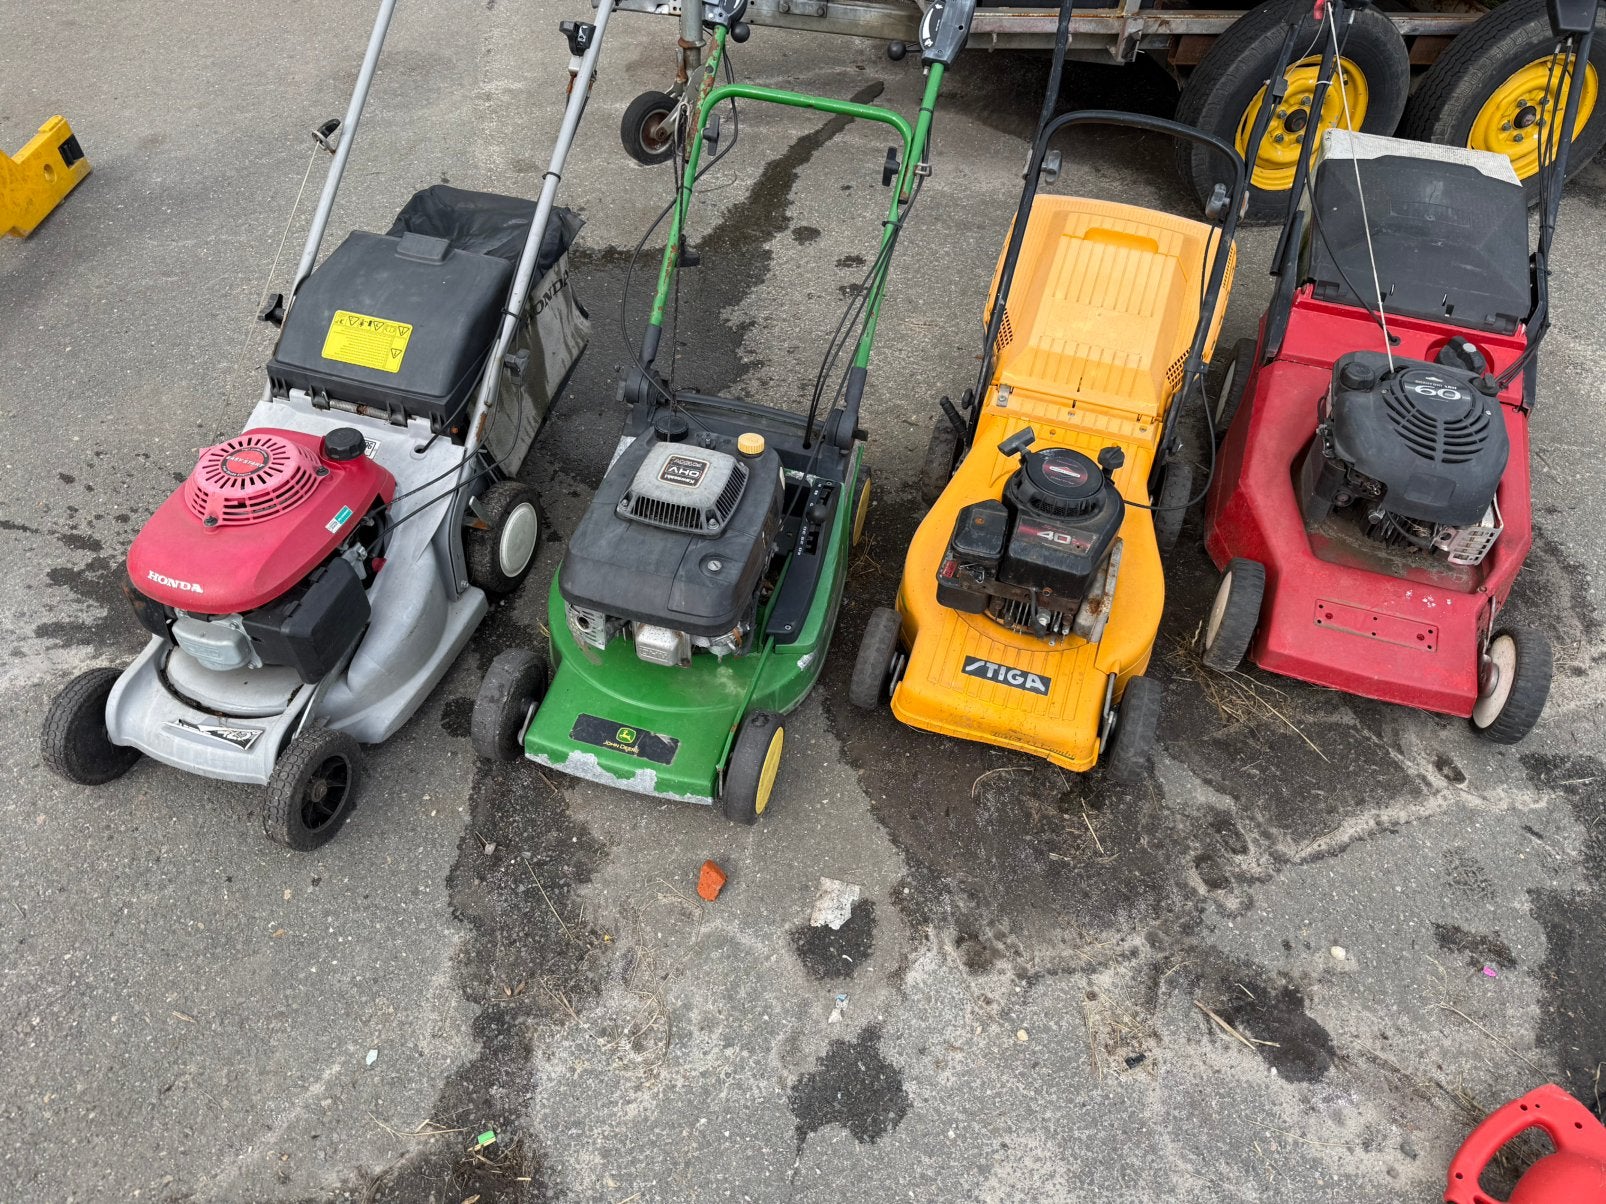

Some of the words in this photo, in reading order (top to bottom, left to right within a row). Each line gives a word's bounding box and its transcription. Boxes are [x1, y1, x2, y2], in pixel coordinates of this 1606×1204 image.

[1414, 385, 1461, 400] 60
[664, 474, 695, 483] Kawasaki
[668, 466, 699, 477] OHV
[1036, 530, 1072, 545] 40
[147, 569, 204, 594] HONDA
[965, 660, 1046, 692] STIGA
